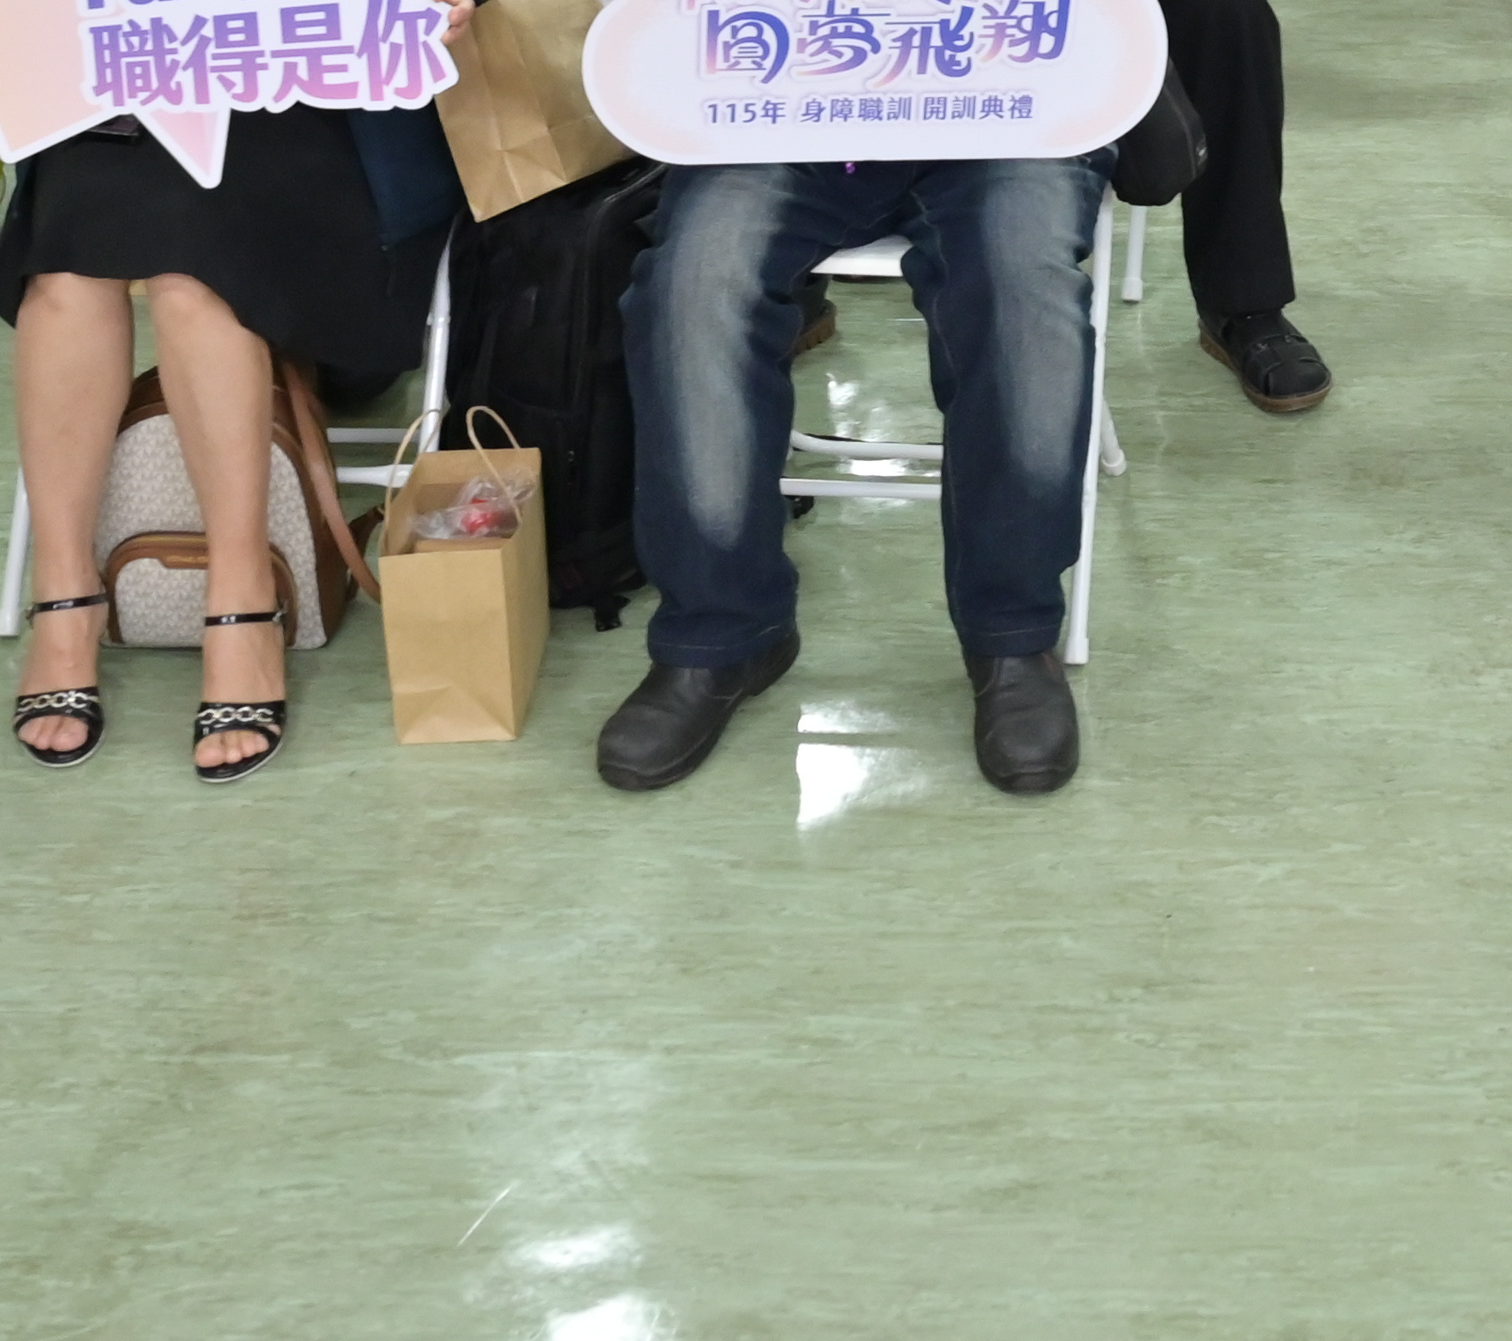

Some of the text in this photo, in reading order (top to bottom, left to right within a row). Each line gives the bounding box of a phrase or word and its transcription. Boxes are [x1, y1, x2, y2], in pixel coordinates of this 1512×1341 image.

[705, 94, 1034, 125] 115年 身障職訓 開訓典禮
